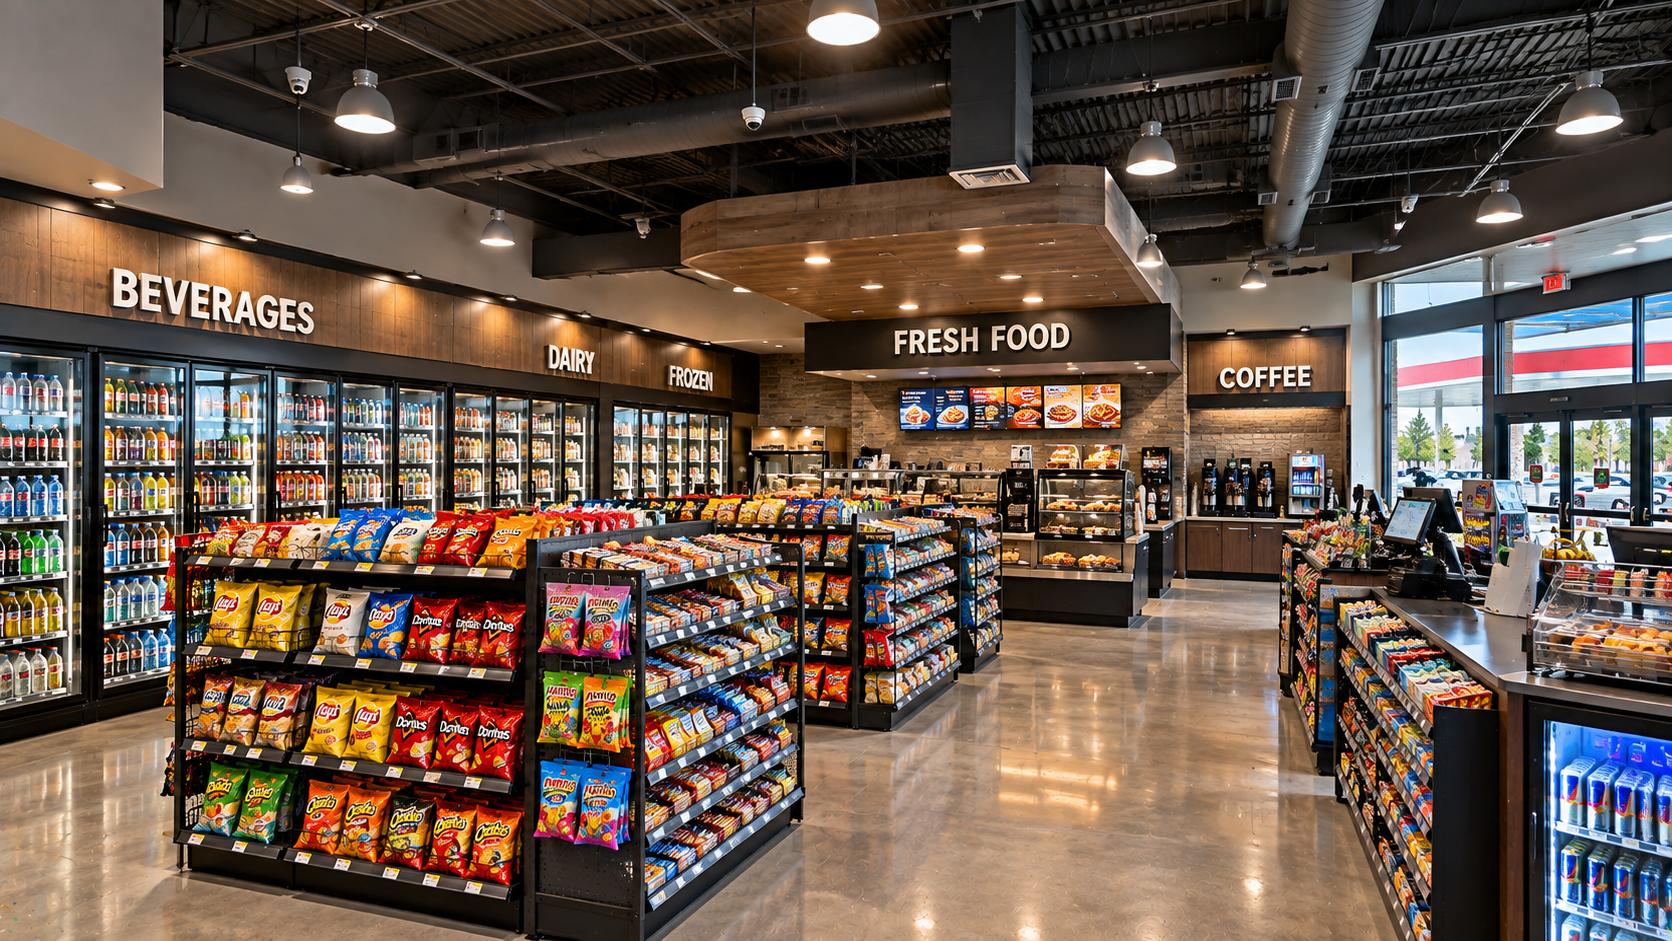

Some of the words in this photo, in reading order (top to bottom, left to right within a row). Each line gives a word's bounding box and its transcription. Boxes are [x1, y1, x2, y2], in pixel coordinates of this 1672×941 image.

[112, 268, 315, 335] BEVERAGES
[894, 327, 979, 355] FRESH
[991, 323, 1070, 351] FOOD
[548, 344, 595, 374] DAIRY
[668, 365, 713, 391] FROZEN
[1219, 365, 1311, 389] COFFEE
